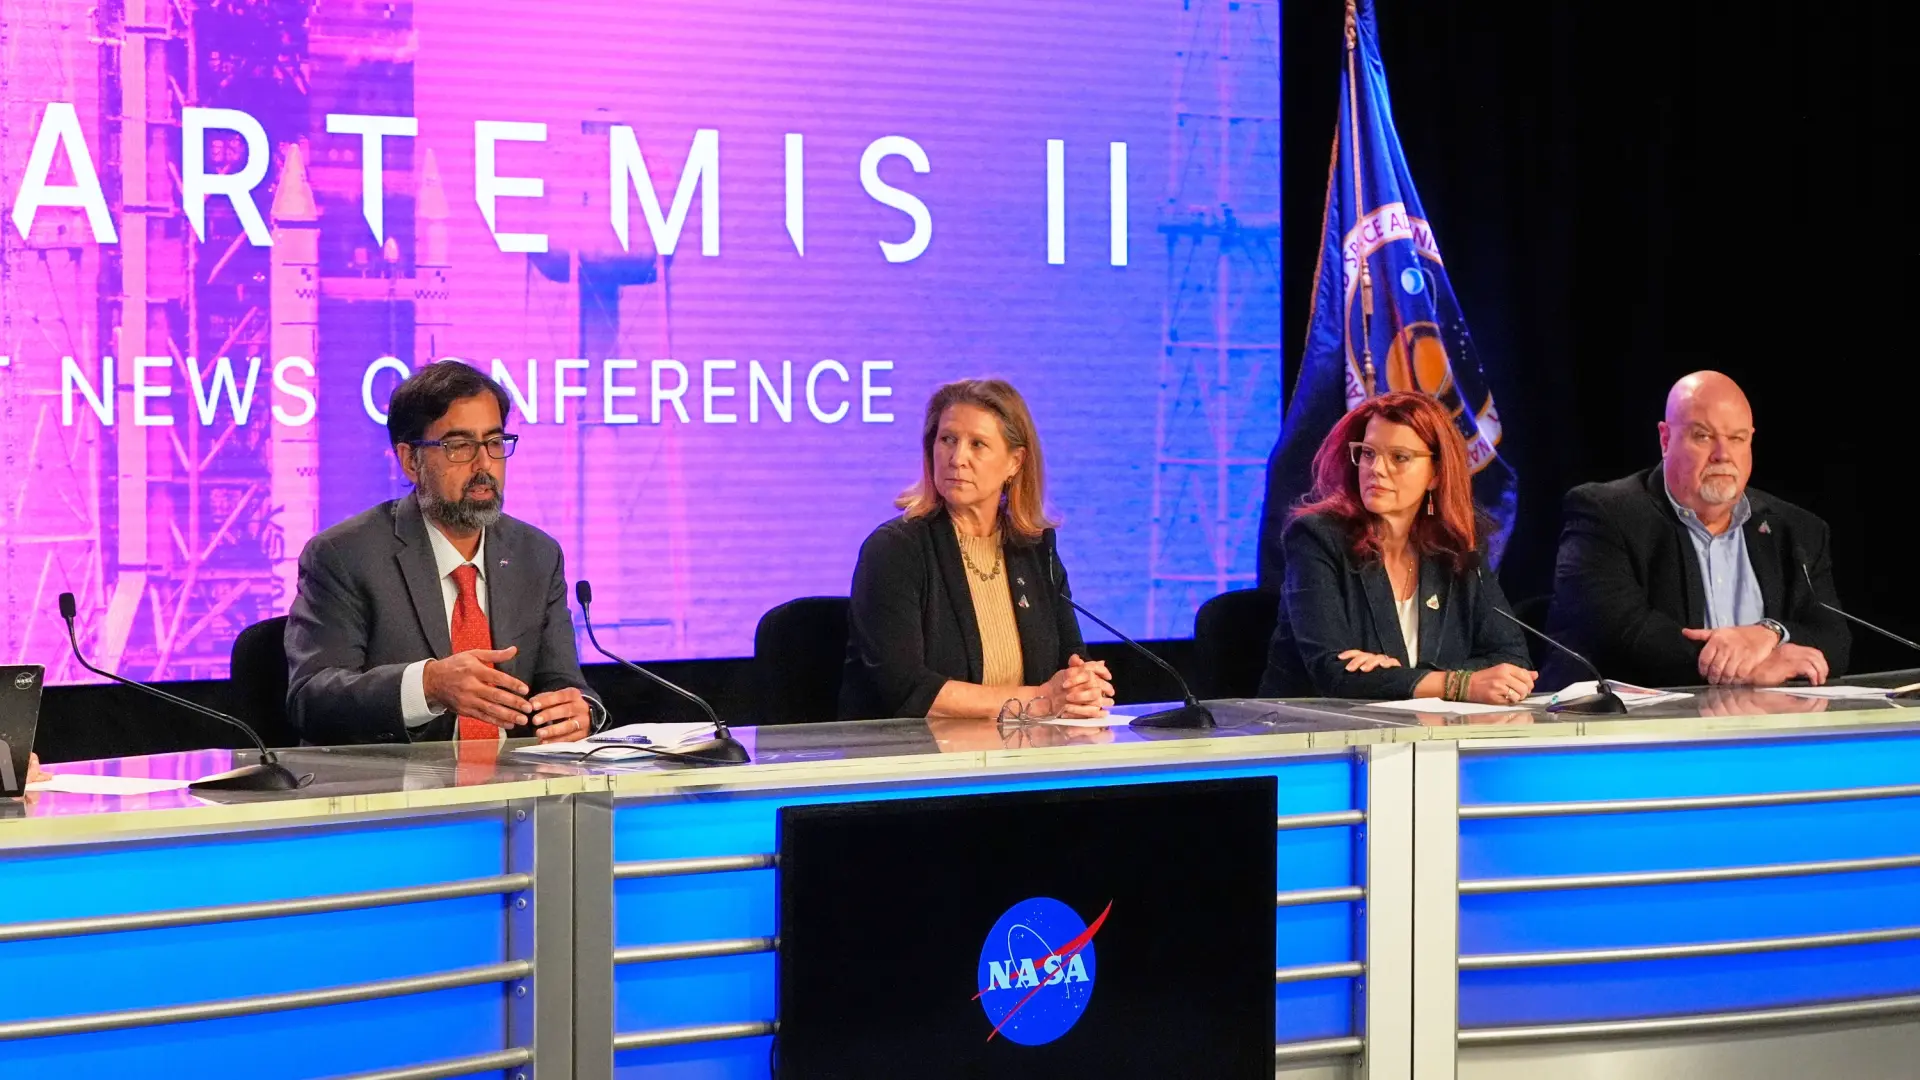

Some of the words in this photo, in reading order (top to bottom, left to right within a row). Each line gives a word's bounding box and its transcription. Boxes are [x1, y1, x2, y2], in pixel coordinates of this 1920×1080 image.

[11, 102, 932, 263] ARTEMIS
[1047, 139, 1128, 266] II
[61, 355, 316, 426] NEWS
[361, 356, 894, 425] CNFERENCE
[987, 953, 1090, 991] NASA
